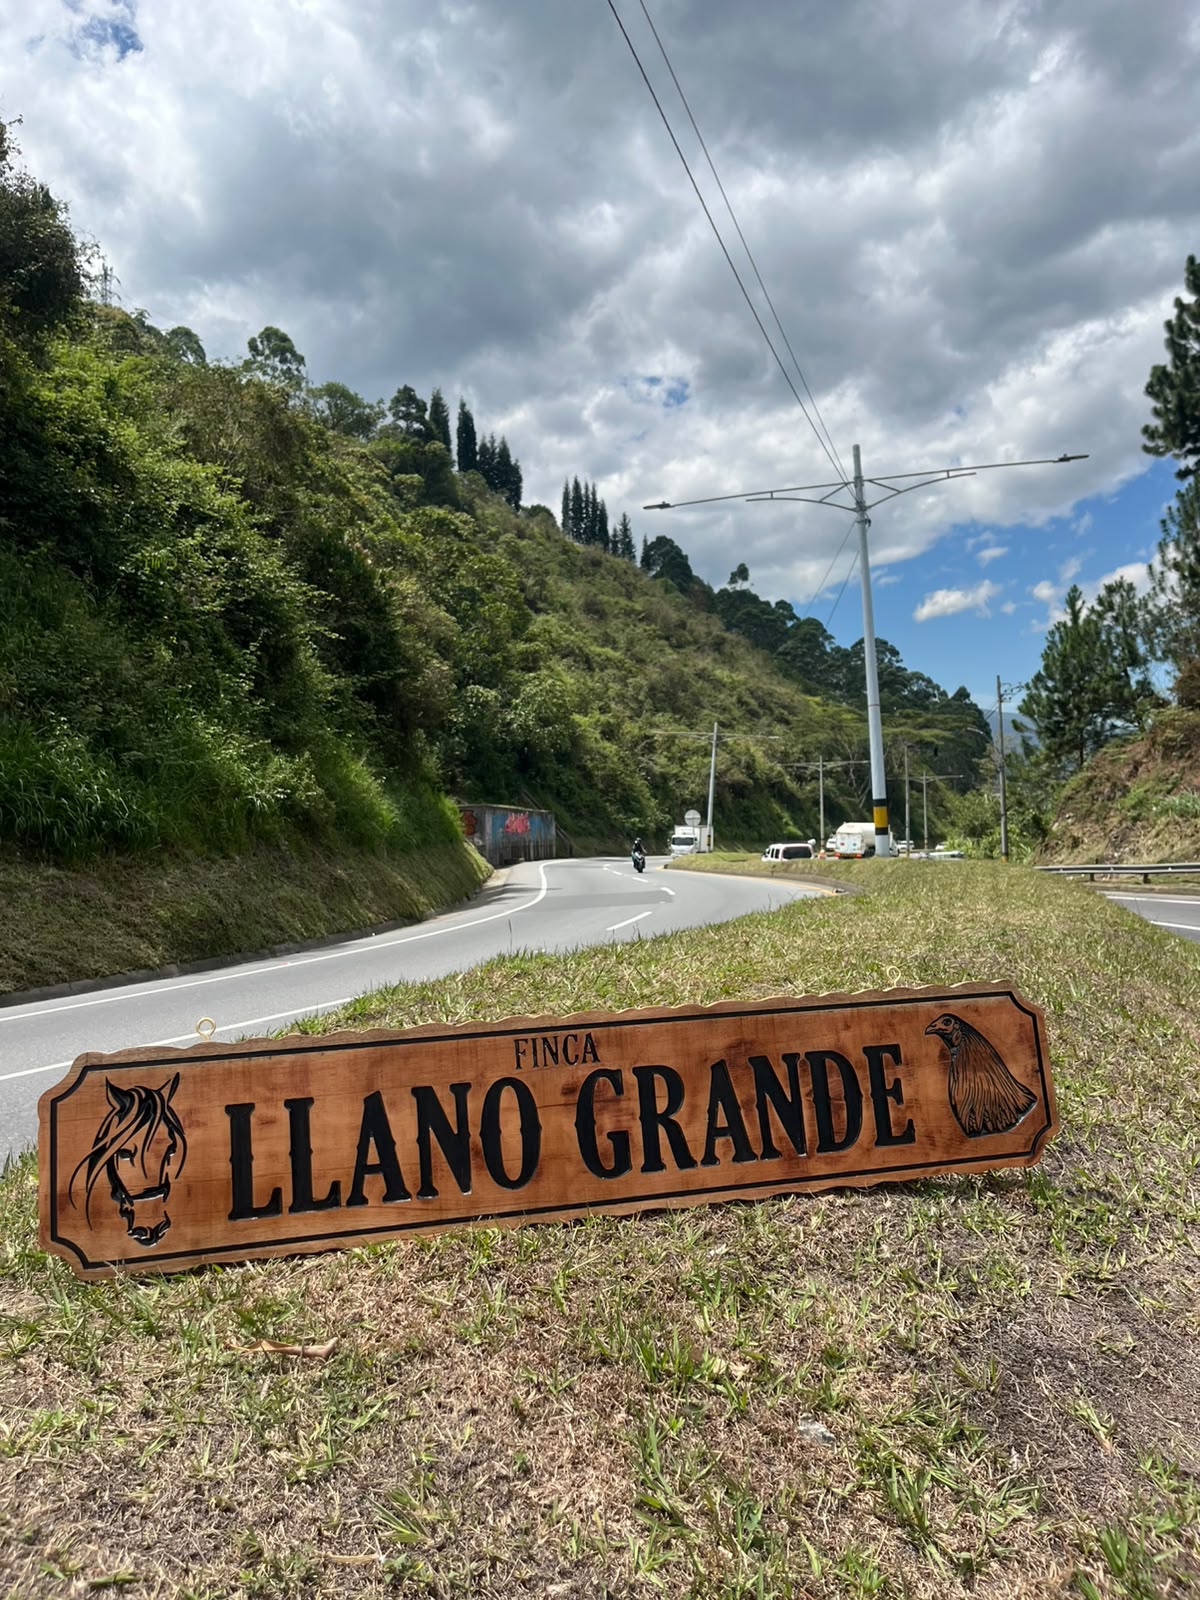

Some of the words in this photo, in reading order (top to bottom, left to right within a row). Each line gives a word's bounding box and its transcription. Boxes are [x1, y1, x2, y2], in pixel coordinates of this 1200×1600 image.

[515, 1033, 600, 1069] FINCA
[225, 1077, 542, 1220] LLANO
[575, 1044, 916, 1179] GRANDE
